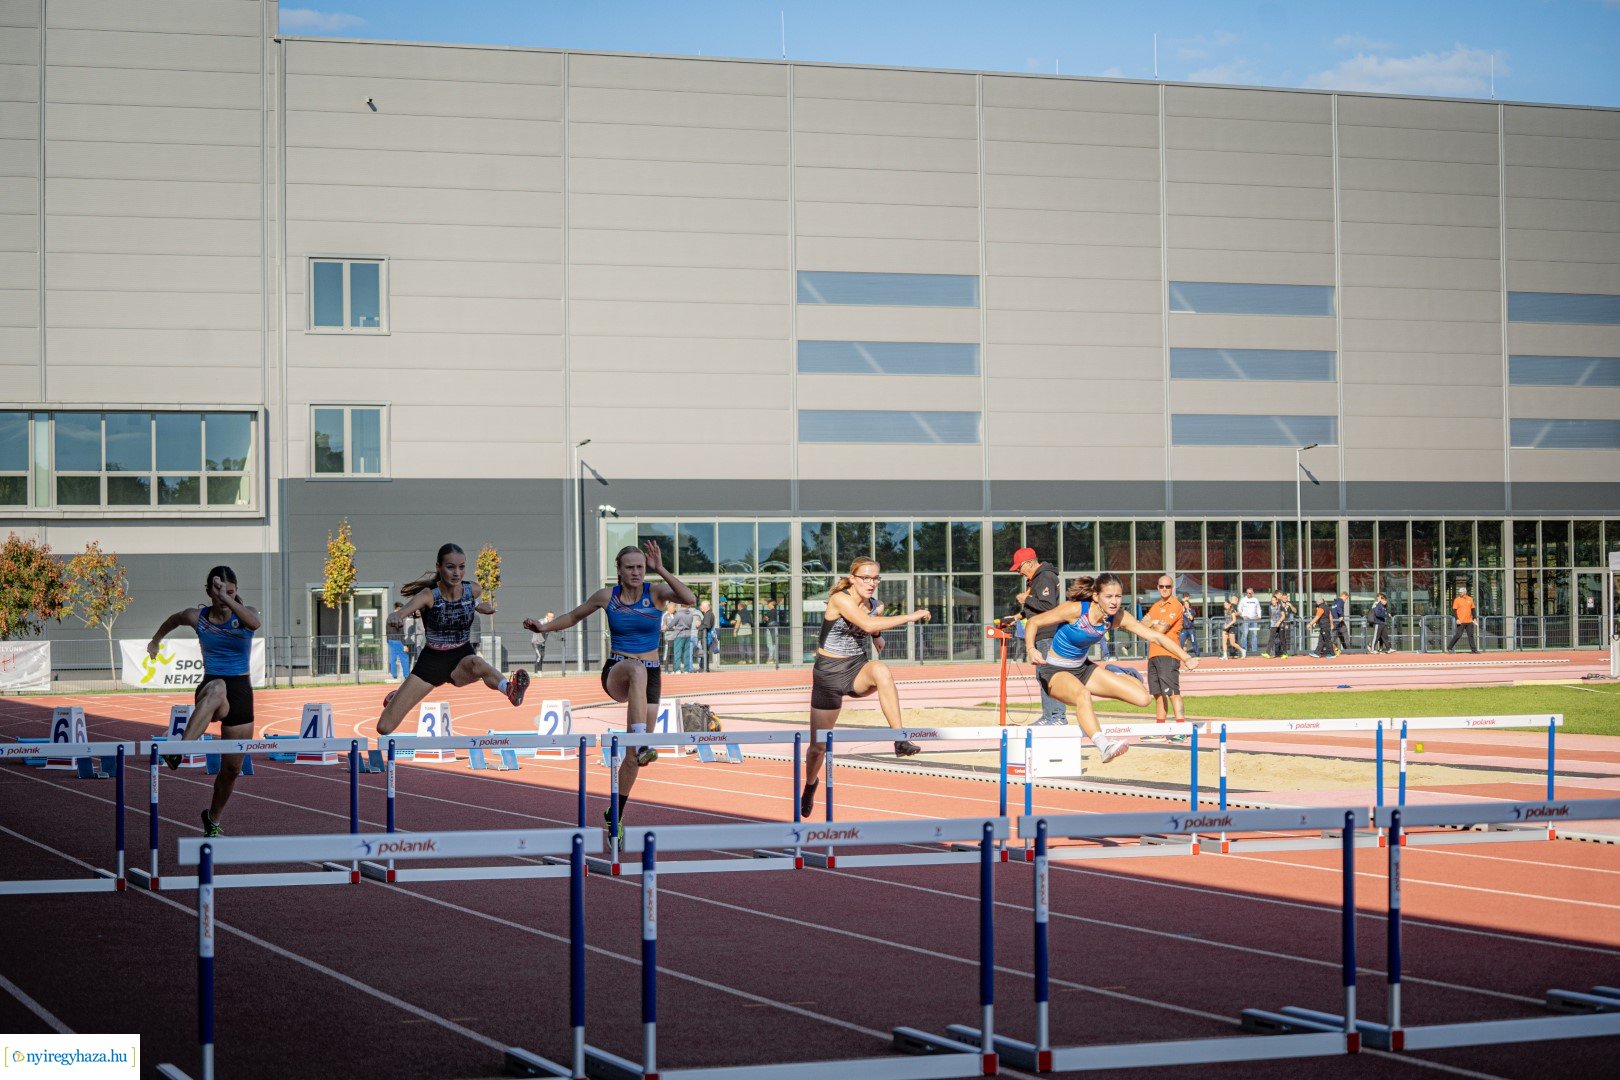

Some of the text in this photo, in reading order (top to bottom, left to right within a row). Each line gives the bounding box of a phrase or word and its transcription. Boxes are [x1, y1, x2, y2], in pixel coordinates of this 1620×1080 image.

[172, 716, 187, 740] 5
[303, 714, 319, 738] 4
[422, 712, 436, 738] 3
[544, 710, 559, 736] 2
[656, 708, 669, 734] 1
[1295, 721, 1320, 730] polanik
[1472, 718, 1496, 727] polanik
[53, 717, 70, 743] 6
[909, 729, 938, 739] polanik
[1105, 726, 1132, 735] polanik
[246, 741, 279, 751] polanik
[479, 737, 510, 747] polanik
[698, 734, 728, 743] polanik
[7, 746, 40, 755] polanik
[1525, 804, 1569, 819] polanik
[1183, 815, 1233, 831] polanik
[806, 827, 860, 843] polanik
[377, 838, 437, 856] polanik
